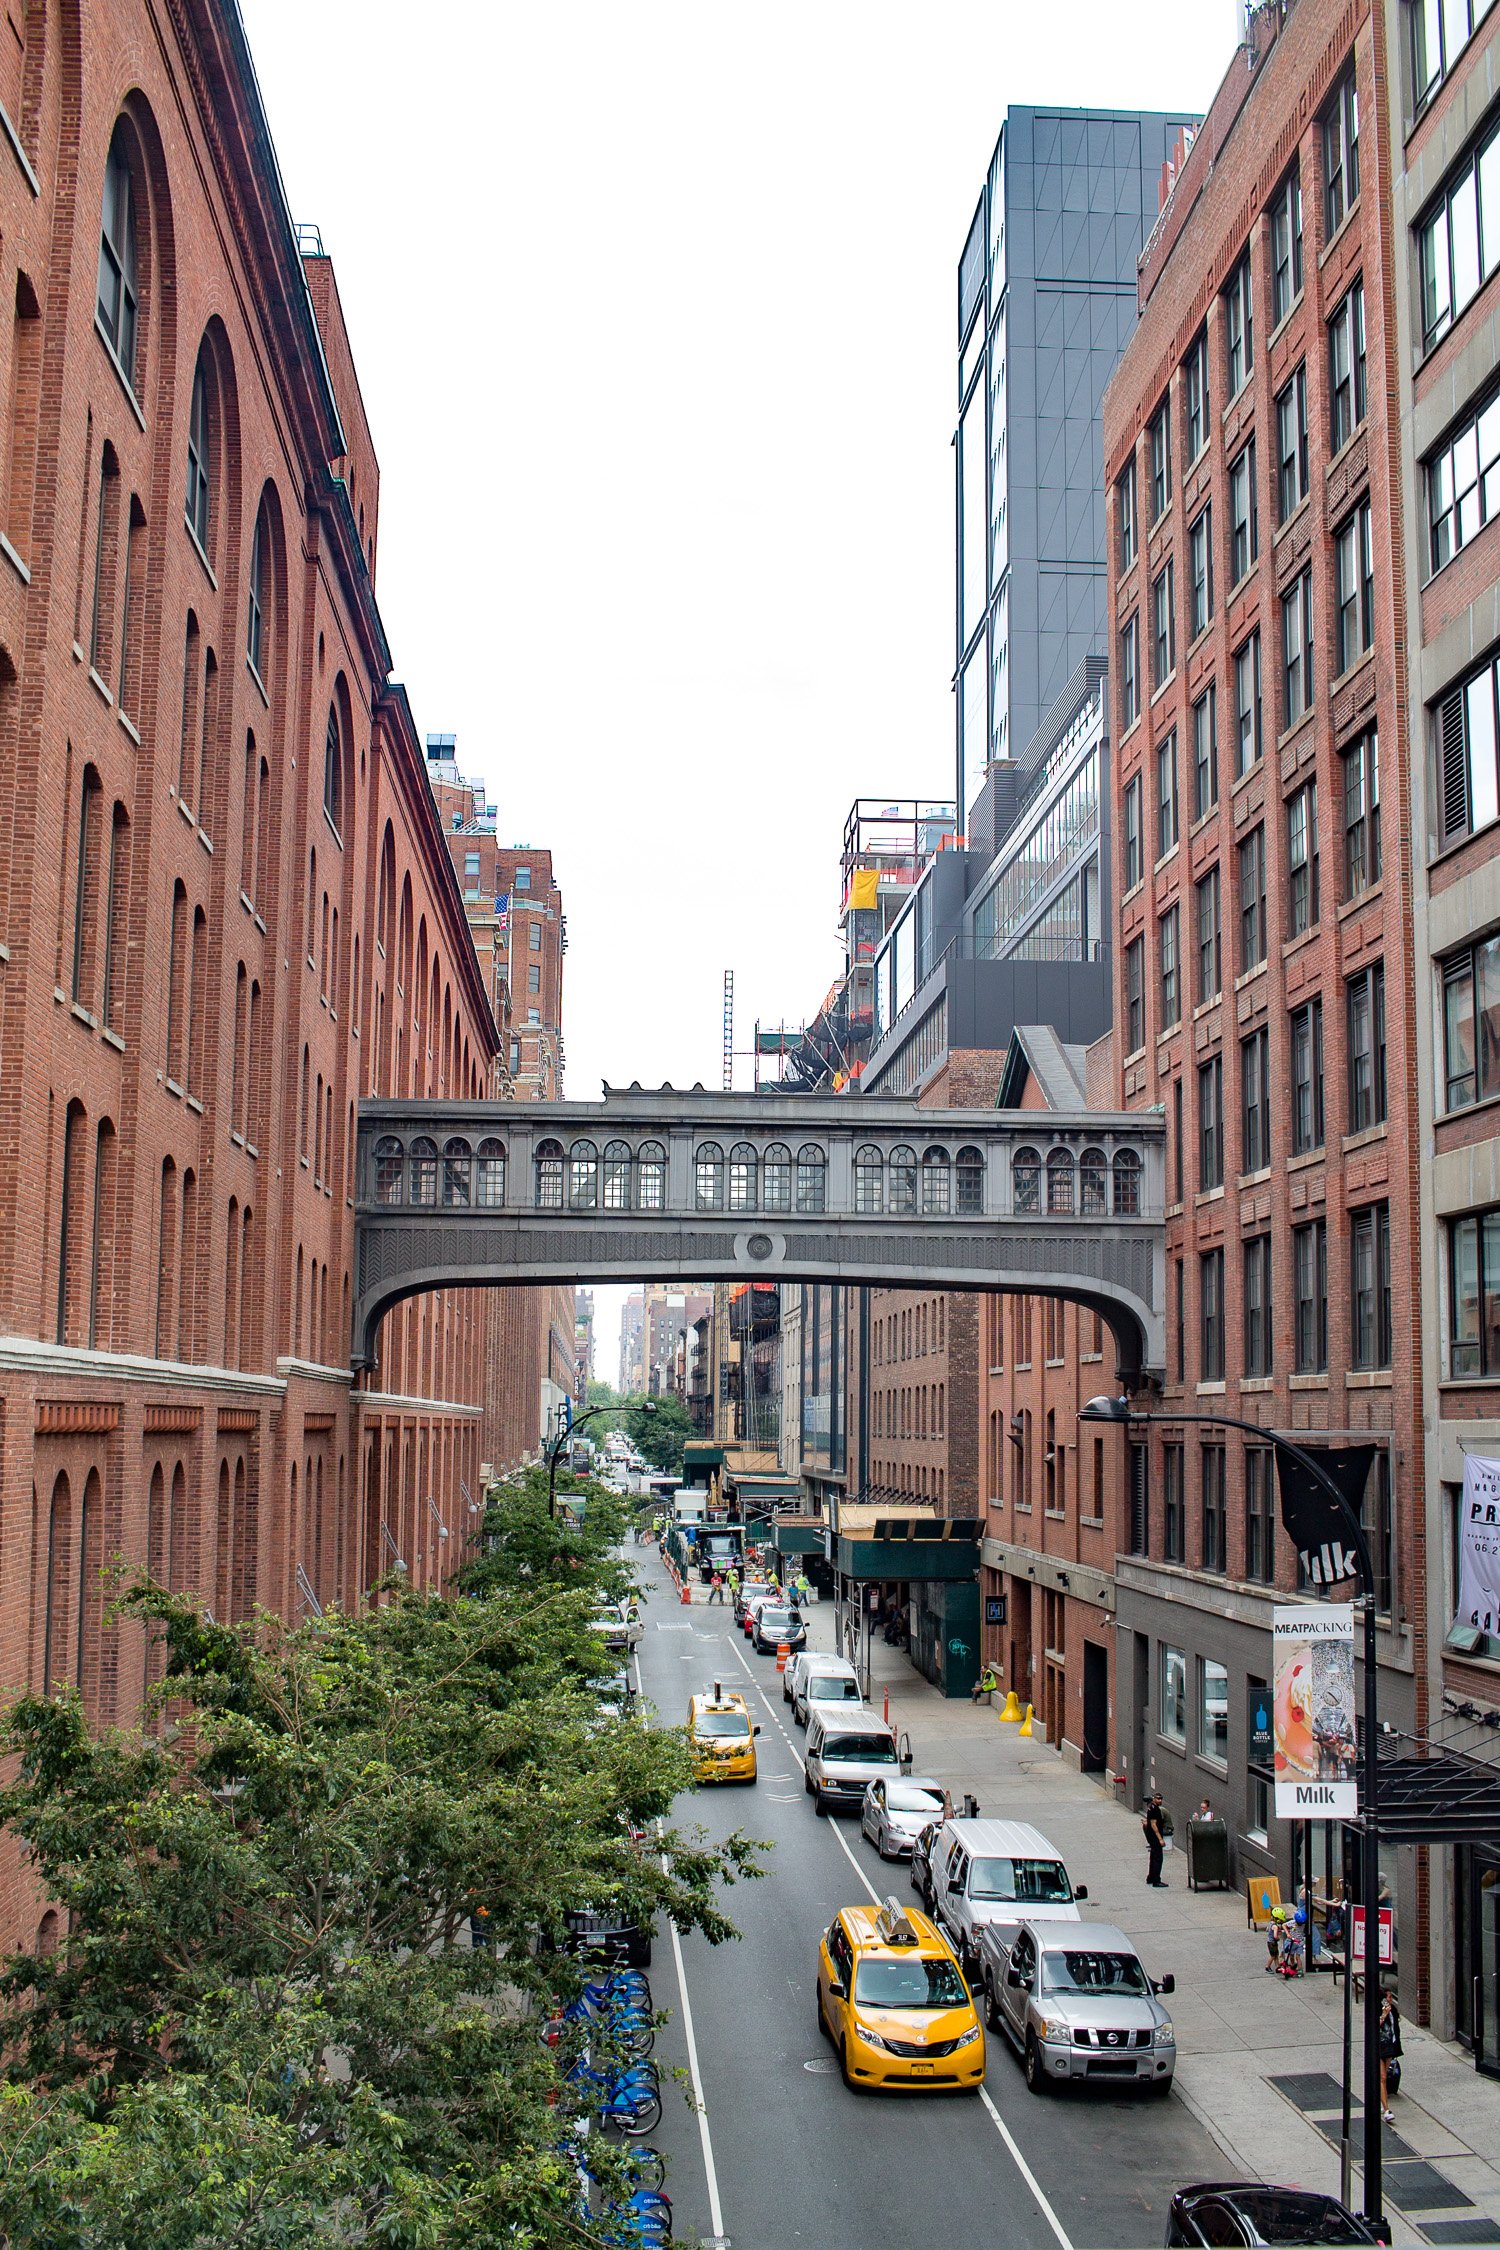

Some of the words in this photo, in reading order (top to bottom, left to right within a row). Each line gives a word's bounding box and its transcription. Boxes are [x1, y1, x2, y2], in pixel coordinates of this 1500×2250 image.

[1471, 1503, 1496, 1522] PR
[1475, 1543, 1500, 1556] 06.2
[1275, 1622, 1352, 1634] MEATPACKING
[1296, 1786, 1336, 1804] Milk
